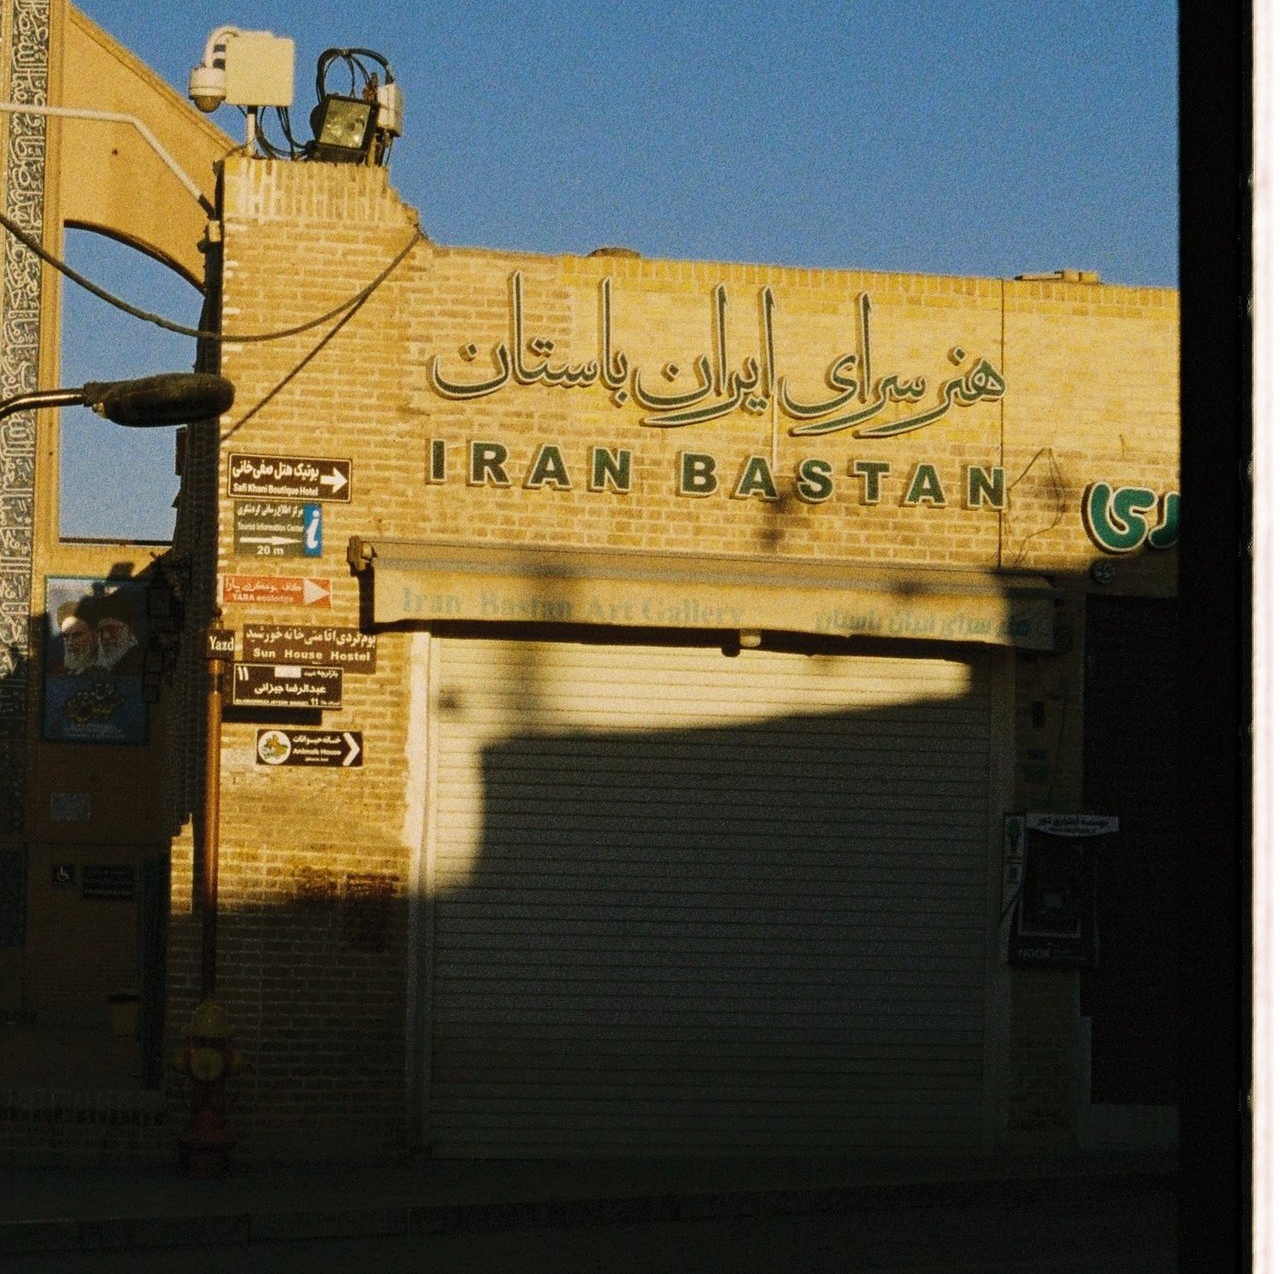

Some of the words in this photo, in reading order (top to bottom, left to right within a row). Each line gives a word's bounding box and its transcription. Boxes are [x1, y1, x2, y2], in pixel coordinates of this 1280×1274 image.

[432, 270, 632, 402] باستان
[634, 284, 776, 428] ایران
[780, 291, 928, 437] سرای
[273, 461, 293, 480] هتل
[426, 437, 634, 495] IRAN
[676, 450, 1008, 511] BASTAN
[268, 484, 299, 498] Boutique
[299, 486, 319, 497] Hotel
[257, 545, 271, 556] 20
[272, 546, 284, 556] m
[232, 593, 255, 602] YARA
[402, 587, 461, 614] Iran
[480, 590, 573, 620] Bastan
[587, 594, 633, 621] Art
[641, 596, 747, 629] Gallery
[208, 635, 235, 651] Yazd
[246, 626, 283, 644] خورشید
[283, 628, 305, 642] خانه
[253, 648, 276, 659] Sun
[284, 650, 323, 661] House
[330, 651, 371, 663] Hostel
